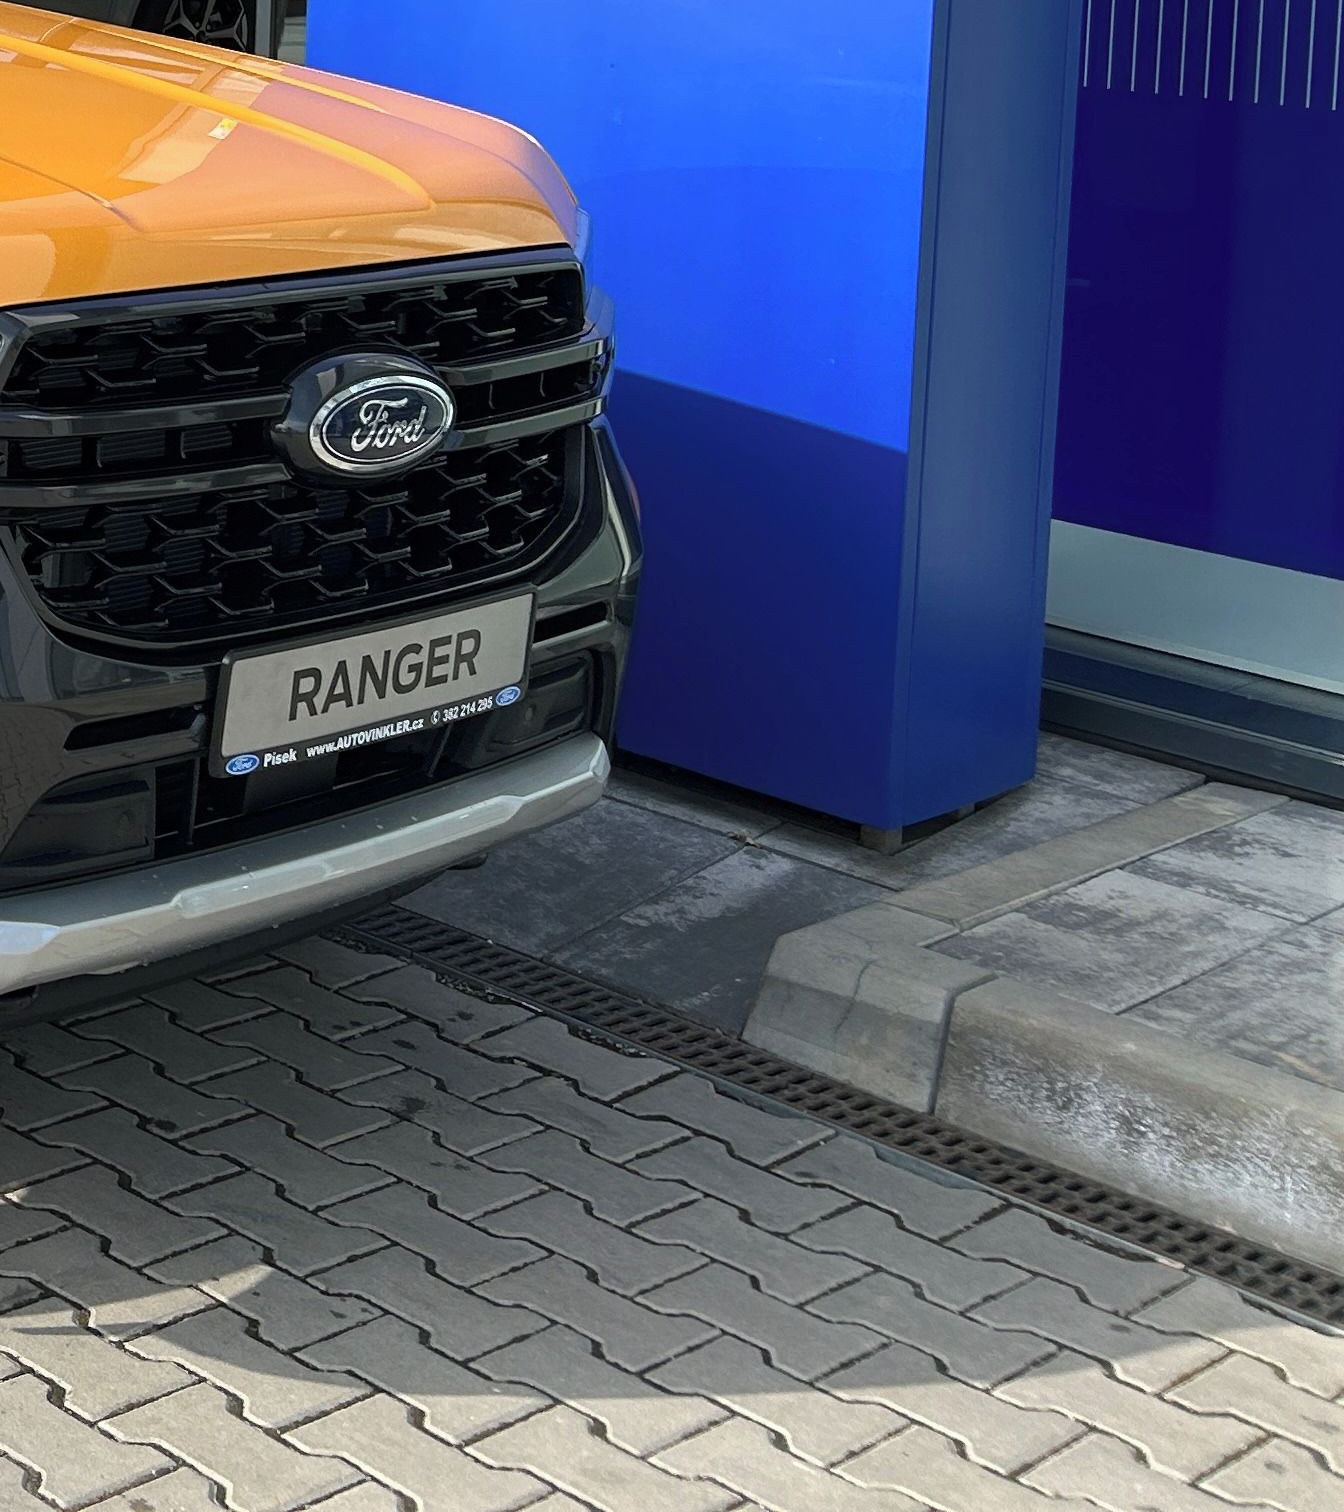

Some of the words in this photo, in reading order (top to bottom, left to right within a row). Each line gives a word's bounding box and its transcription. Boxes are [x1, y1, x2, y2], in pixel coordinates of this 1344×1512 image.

[350, 397, 427, 452] Ford
[288, 629, 481, 721] RANGER
[306, 718, 424, 757] www.AUTOVINKLER.cz
